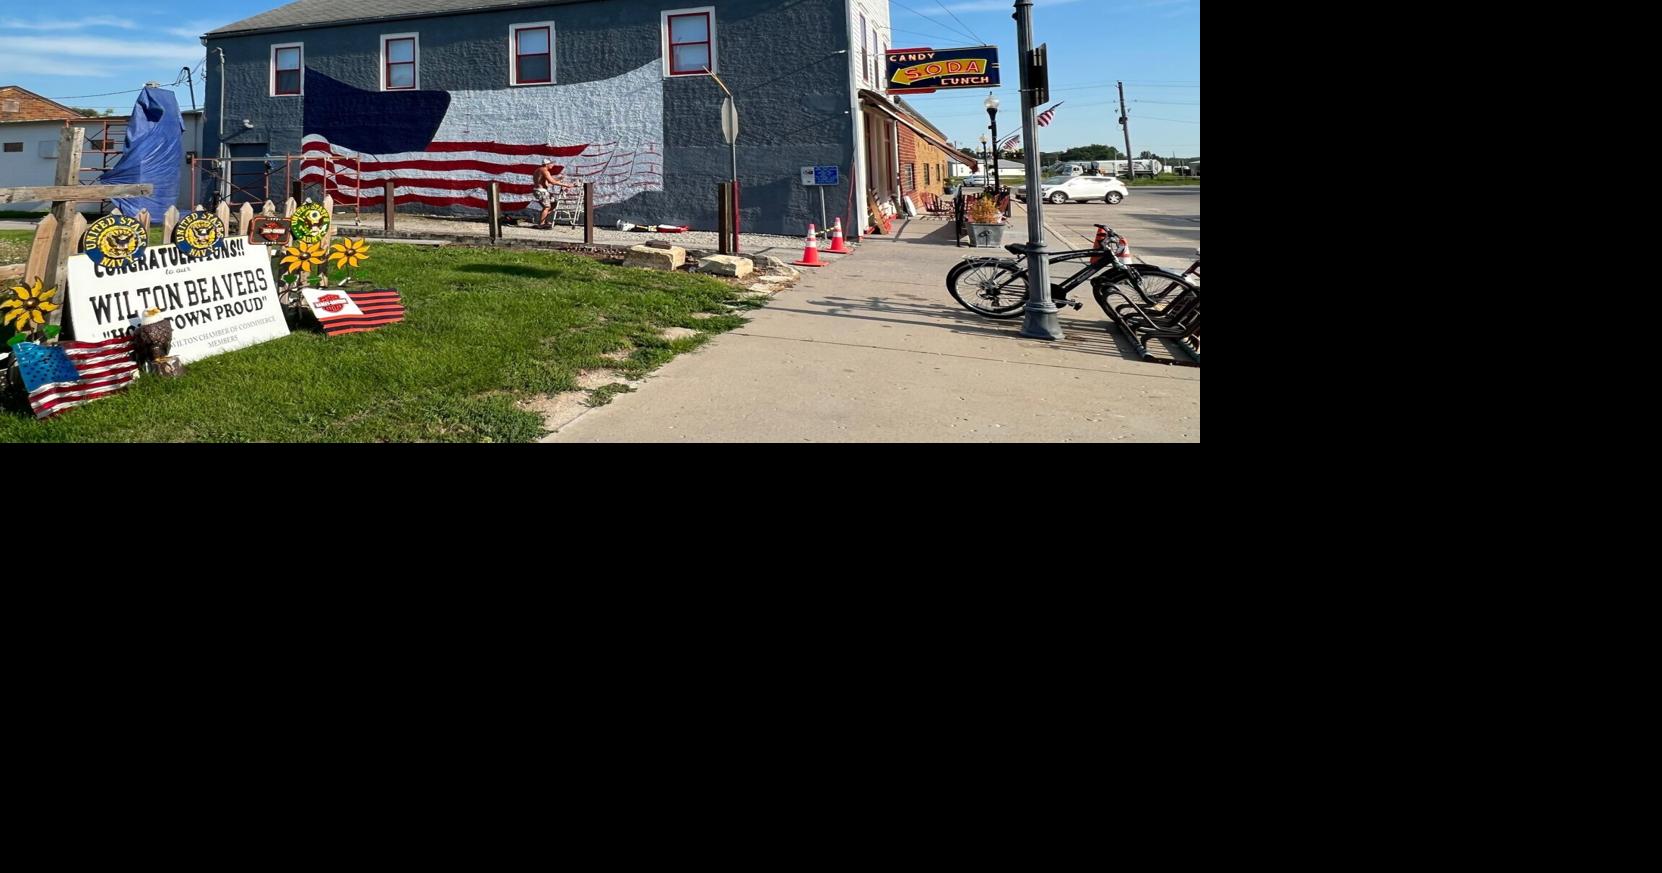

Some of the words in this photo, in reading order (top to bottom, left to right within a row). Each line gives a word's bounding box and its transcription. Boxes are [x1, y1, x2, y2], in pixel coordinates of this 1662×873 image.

[889, 53, 935, 62] CANDY
[904, 61, 980, 80] SODA
[941, 76, 989, 85] LUNCH
[86, 217, 116, 250] UNITED
[120, 217, 147, 247] STATES
[177, 213, 199, 242] UNITED
[202, 212, 224, 239] STATES
[94, 239, 245, 278] CGRATULONS!!
[189, 245, 215, 257] NAVY
[101, 255, 133, 267] NAVY
[89, 282, 183, 325] WILTON
[184, 267, 268, 307] BEAVERS
[214, 296, 267, 320] PROUD"
[199, 328, 230, 342] CHAMBER
[230, 325, 239, 334] OF
[208, 335, 239, 348] MEMBERS
